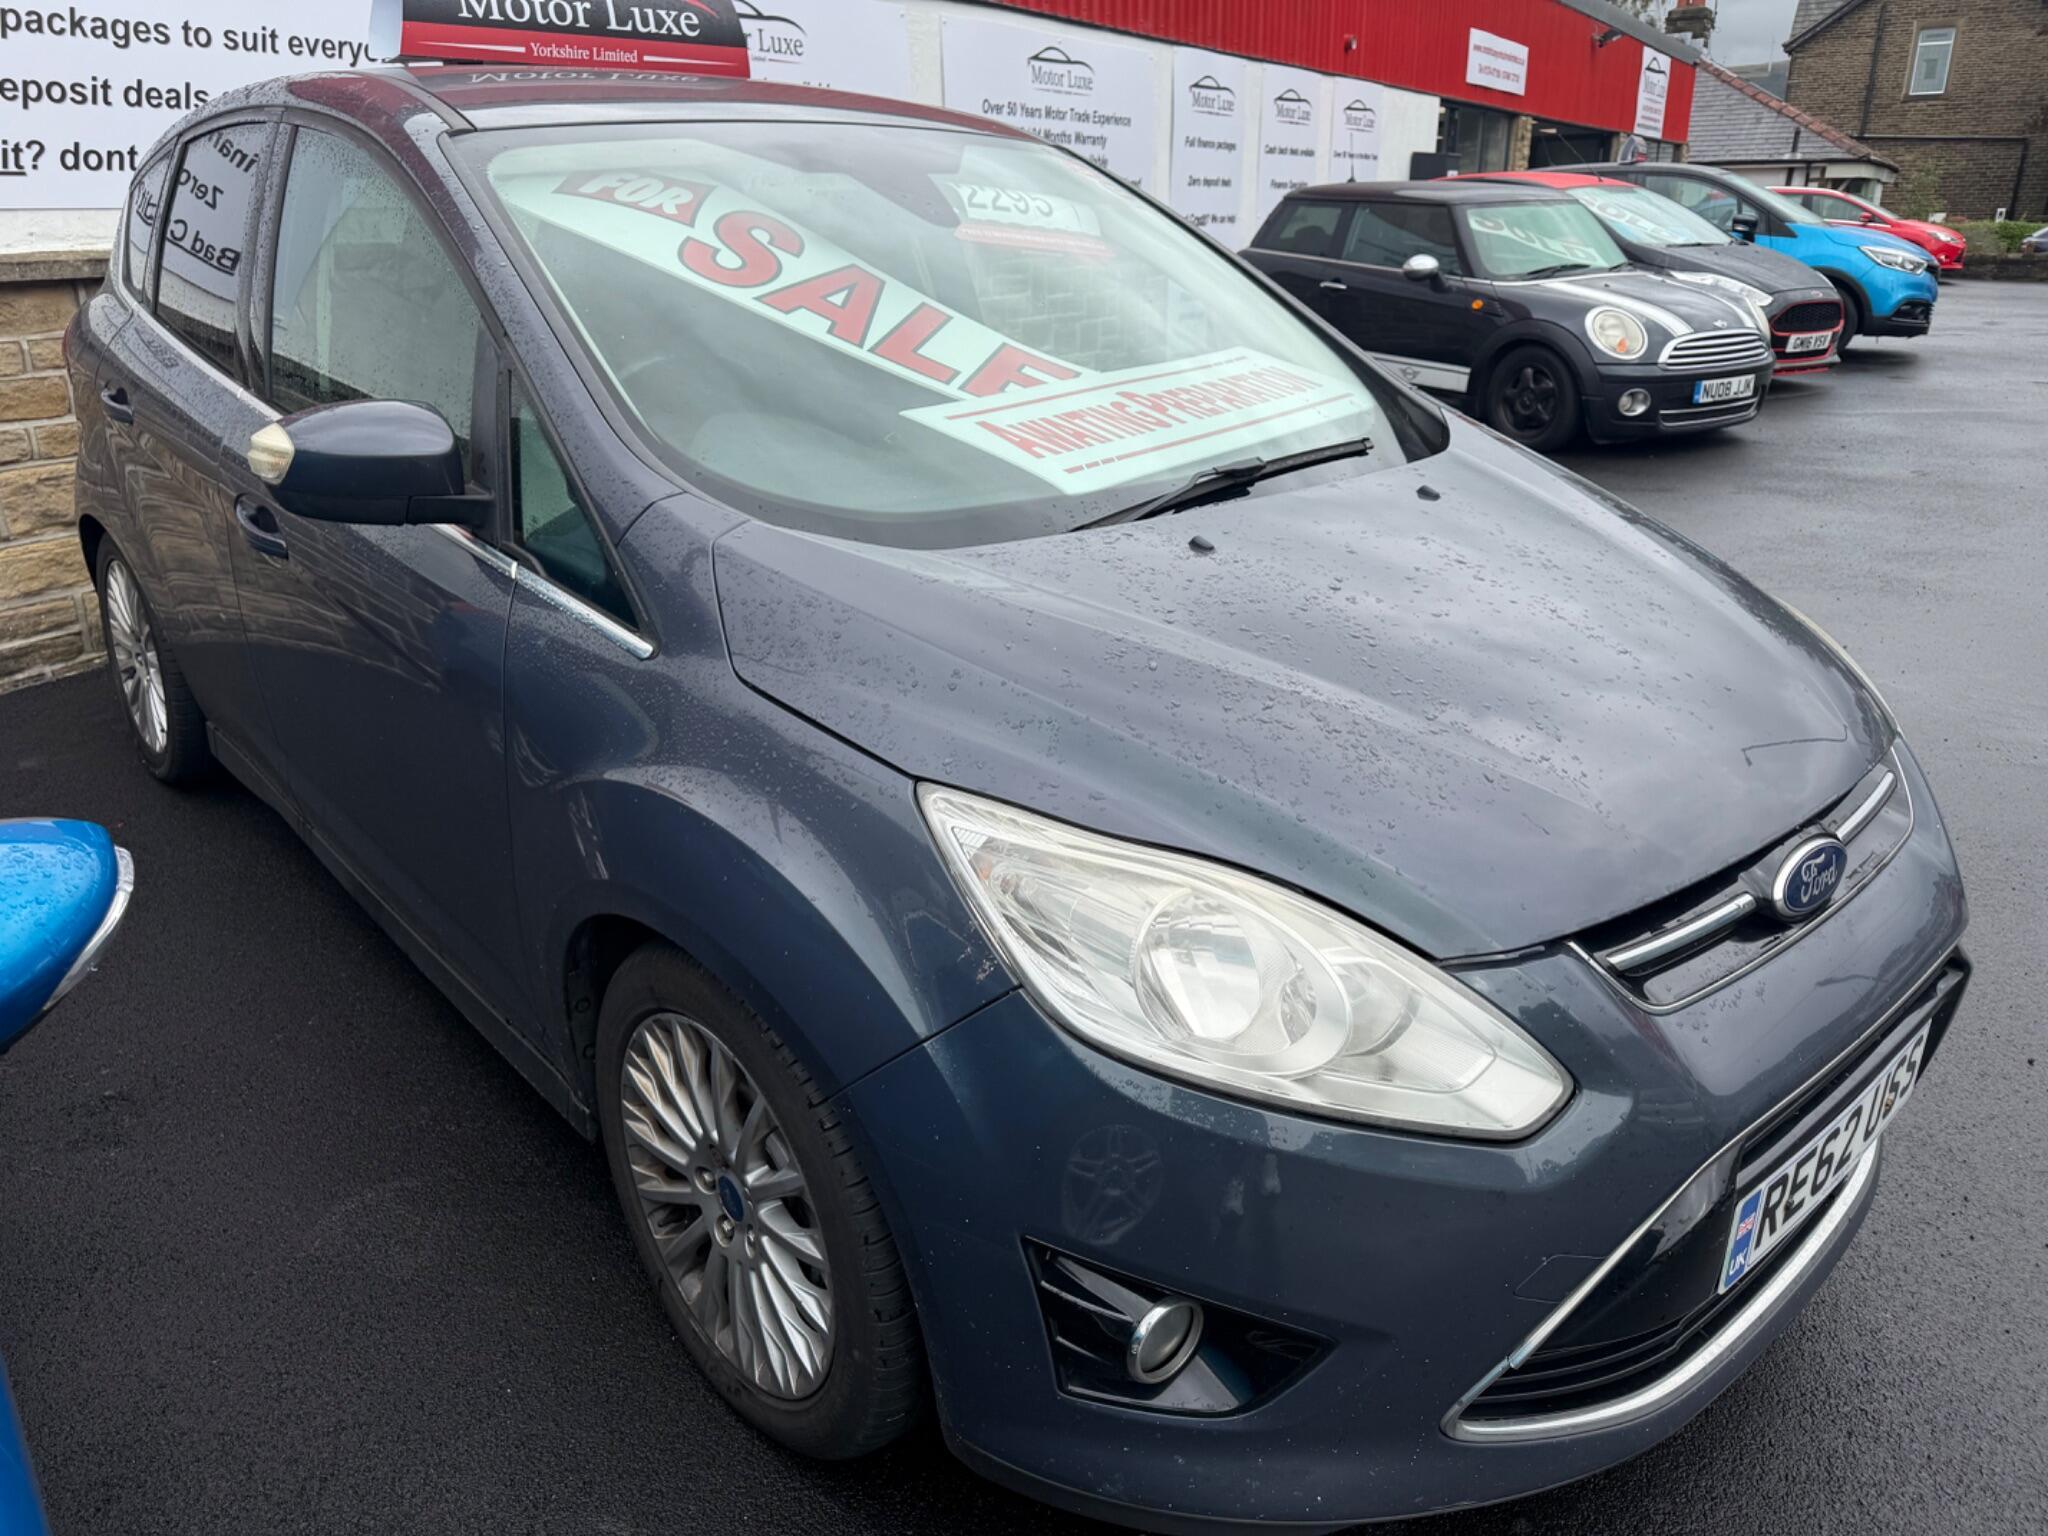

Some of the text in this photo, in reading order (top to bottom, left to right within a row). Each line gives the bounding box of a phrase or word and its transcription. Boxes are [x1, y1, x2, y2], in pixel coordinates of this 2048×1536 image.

[0, 7, 171, 49] packages
[181, 20, 212, 48] to
[223, 26, 280, 54] suit
[458, 0, 700, 37] Motor Luxe
[530, 43, 638, 63] Yorkshire Limited
[757, 28, 805, 56] Luxe
[0, 76, 208, 110] eposit deals
[1031, 64, 1093, 91] Motor Luxe
[982, 98, 1131, 128] Over 50 Years Motor Trade Experience
[60, 142, 139, 171] dont
[579, 173, 695, 216] FOR
[678, 210, 1083, 398] SALE
[1801, 853, 1837, 903] Ford
[1754, 1104, 1863, 1250] RE62
[1728, 1248, 1748, 1276] UK
